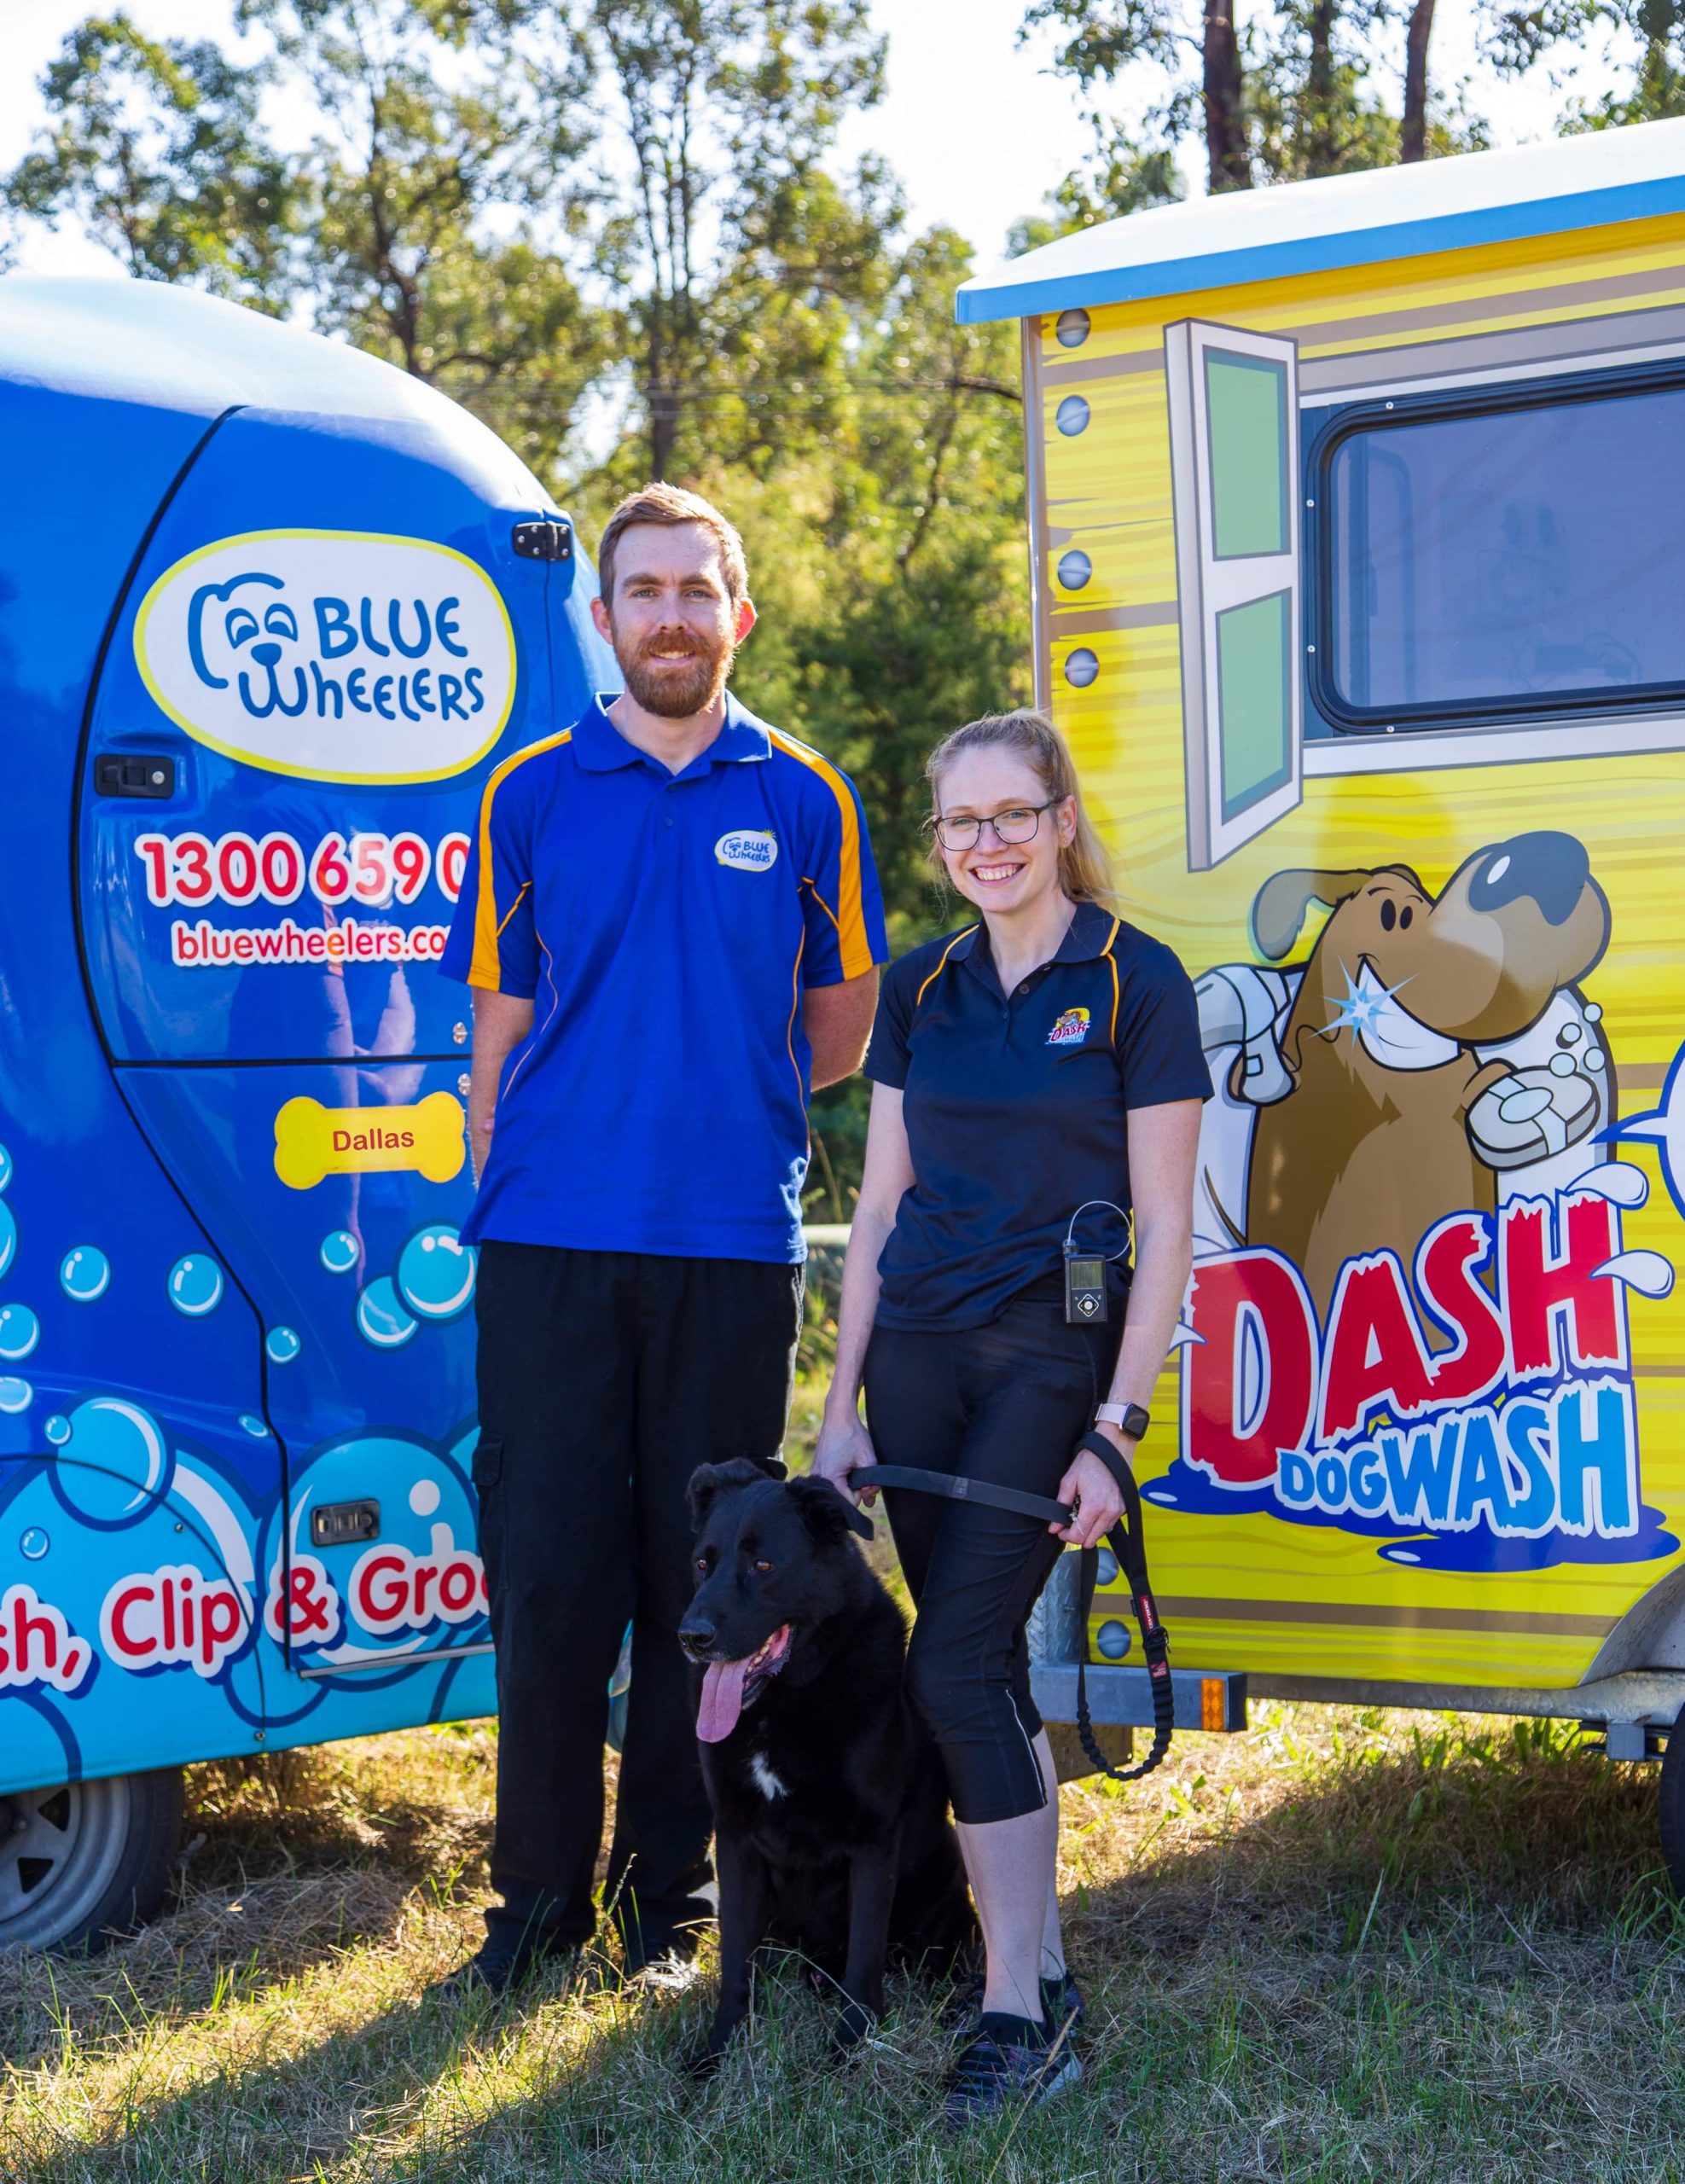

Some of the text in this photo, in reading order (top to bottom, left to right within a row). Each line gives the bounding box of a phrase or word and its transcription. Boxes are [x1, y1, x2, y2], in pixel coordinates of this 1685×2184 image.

[312, 595, 469, 660] BLUE
[142, 839, 299, 899] 1300
[315, 839, 425, 897] 659
[743, 840, 770, 854] BLUE
[177, 923, 447, 961] bluewheelers.co
[1050, 1023, 1087, 1042] DASH
[332, 1128, 415, 1153] Dallas
[1189, 1196, 1619, 1484] DASH
[0, 1555, 489, 1678] h, Clip & Gro
